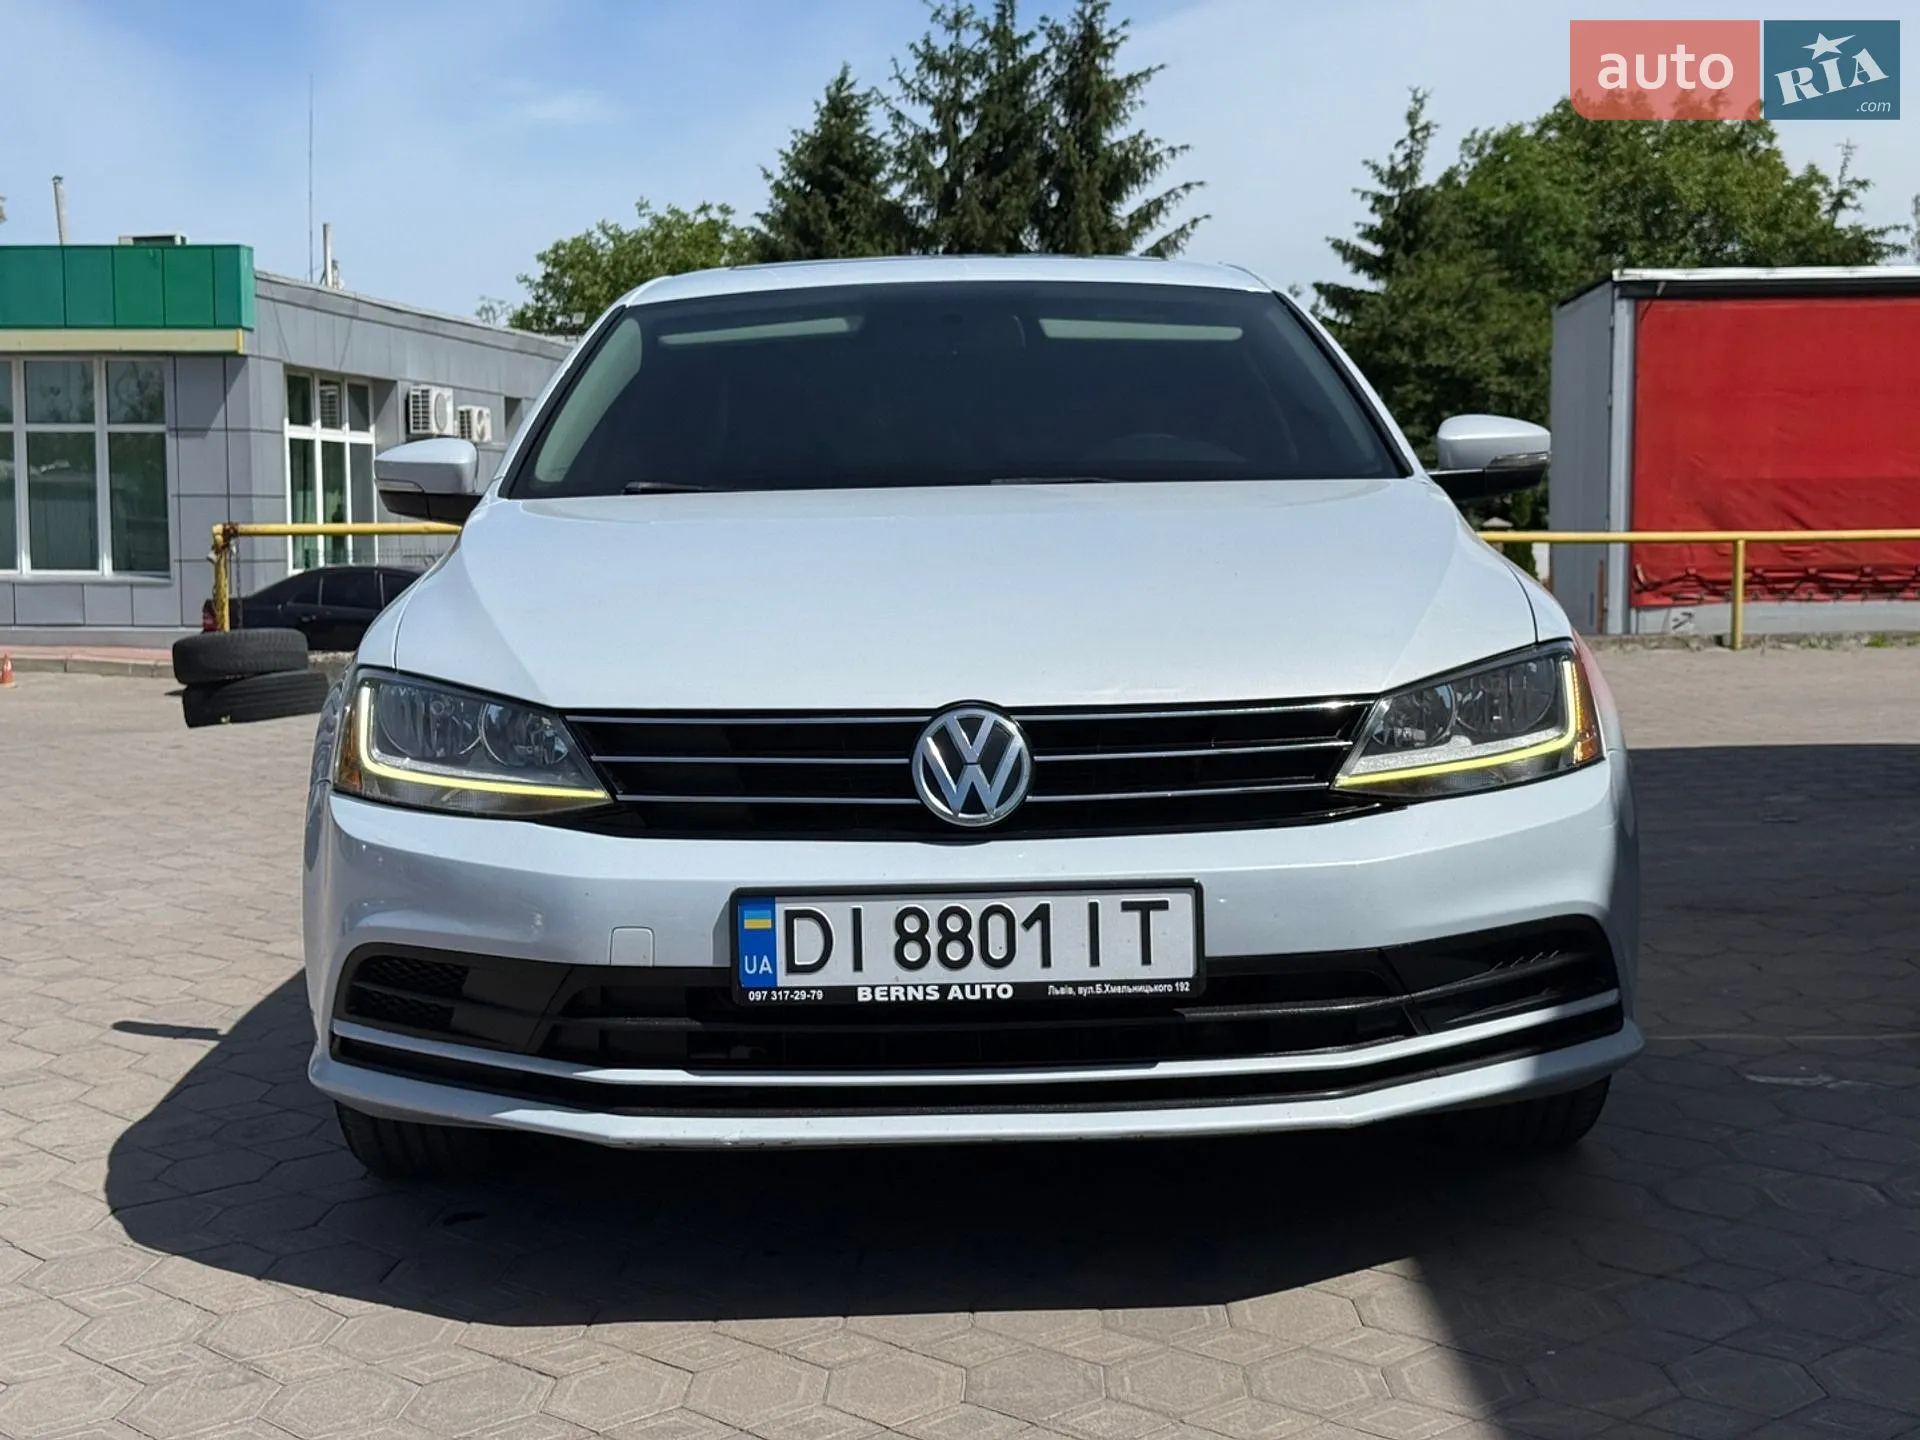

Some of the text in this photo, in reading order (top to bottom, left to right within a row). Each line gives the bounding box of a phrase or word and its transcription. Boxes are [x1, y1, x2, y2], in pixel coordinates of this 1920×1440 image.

[784, 899, 1170, 975] DI 8801 IT
[744, 954, 774, 975] UA
[748, 989, 824, 1001] 097 317-29-79
[856, 983, 1014, 1002] BERNS AUTO
[1174, 981, 1191, 992] 192
